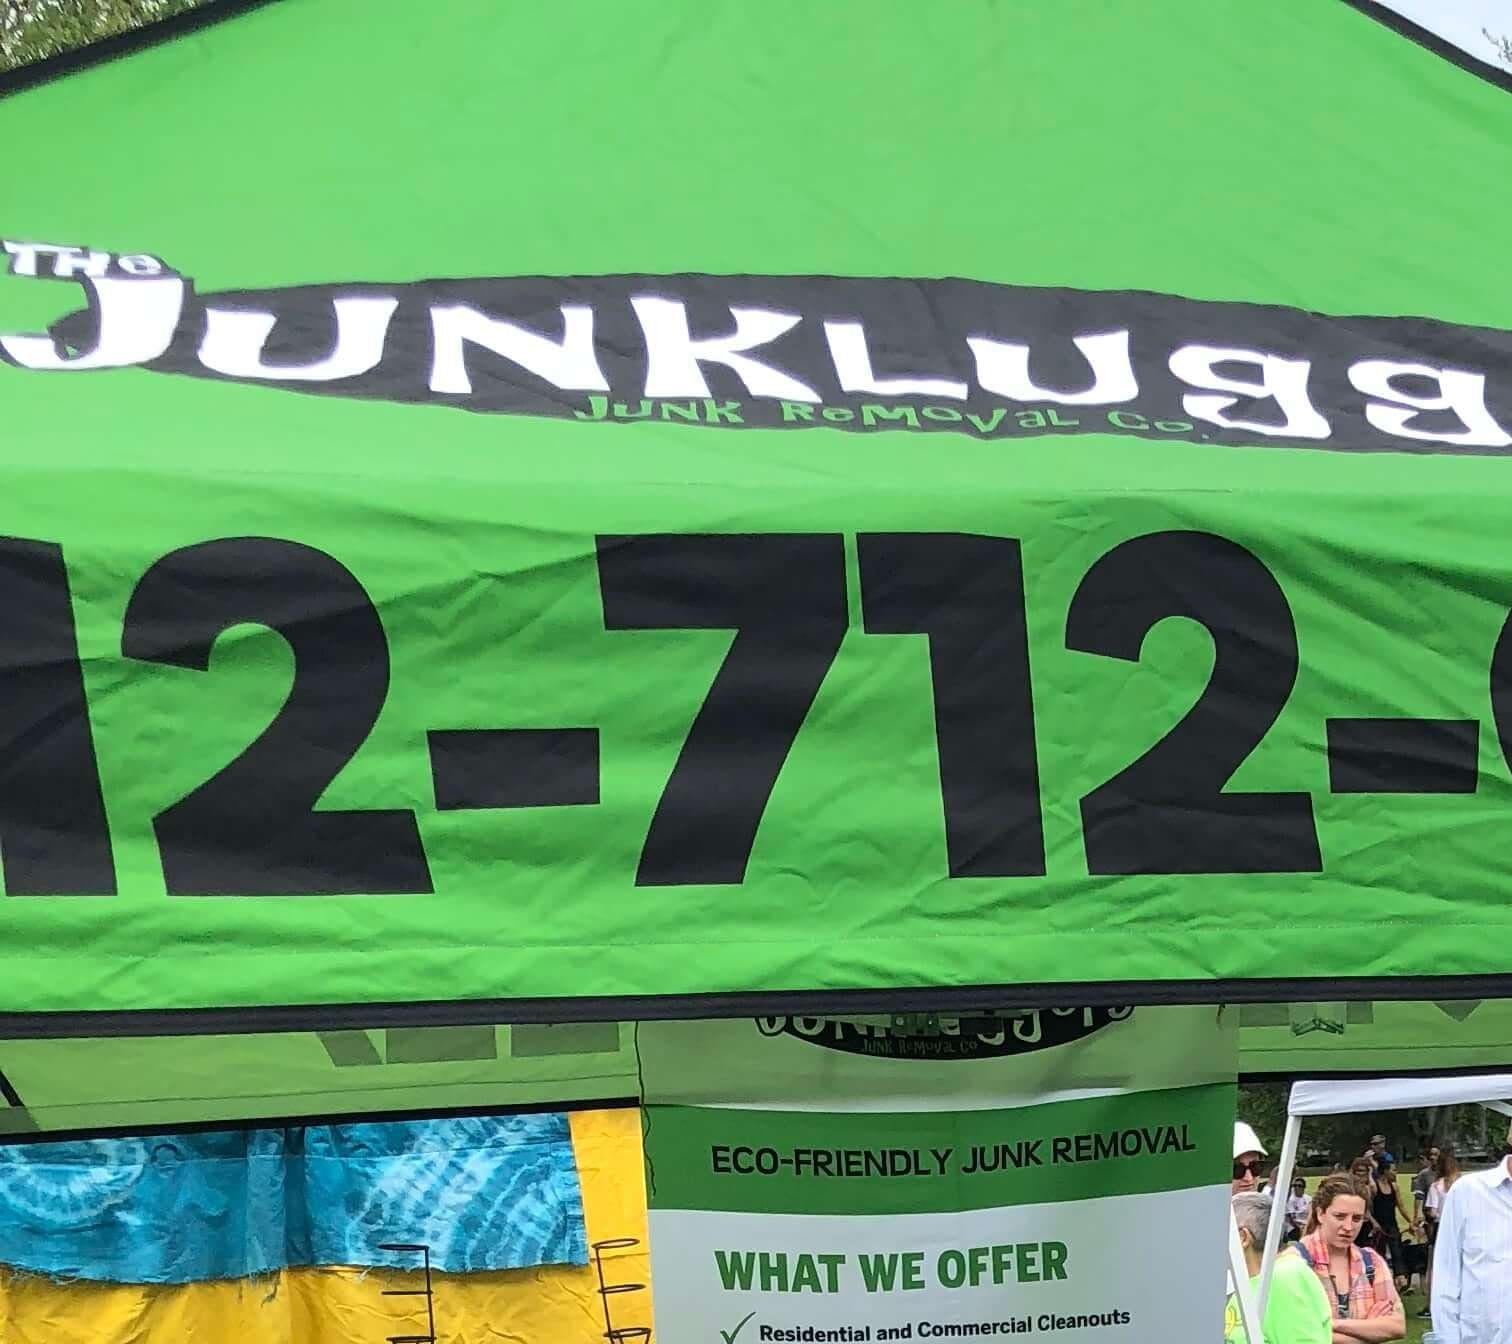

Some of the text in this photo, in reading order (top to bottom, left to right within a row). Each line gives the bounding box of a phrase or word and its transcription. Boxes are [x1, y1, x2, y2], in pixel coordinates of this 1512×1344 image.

[573, 395, 744, 424] JUNK
[711, 1124, 1196, 1177] ECO-FRIENDLY JUNK REMOVAL
[714, 1240, 1069, 1294] WHAT WE OFFER
[759, 1308, 1131, 1344] Residential and Commercial Cleanouts
